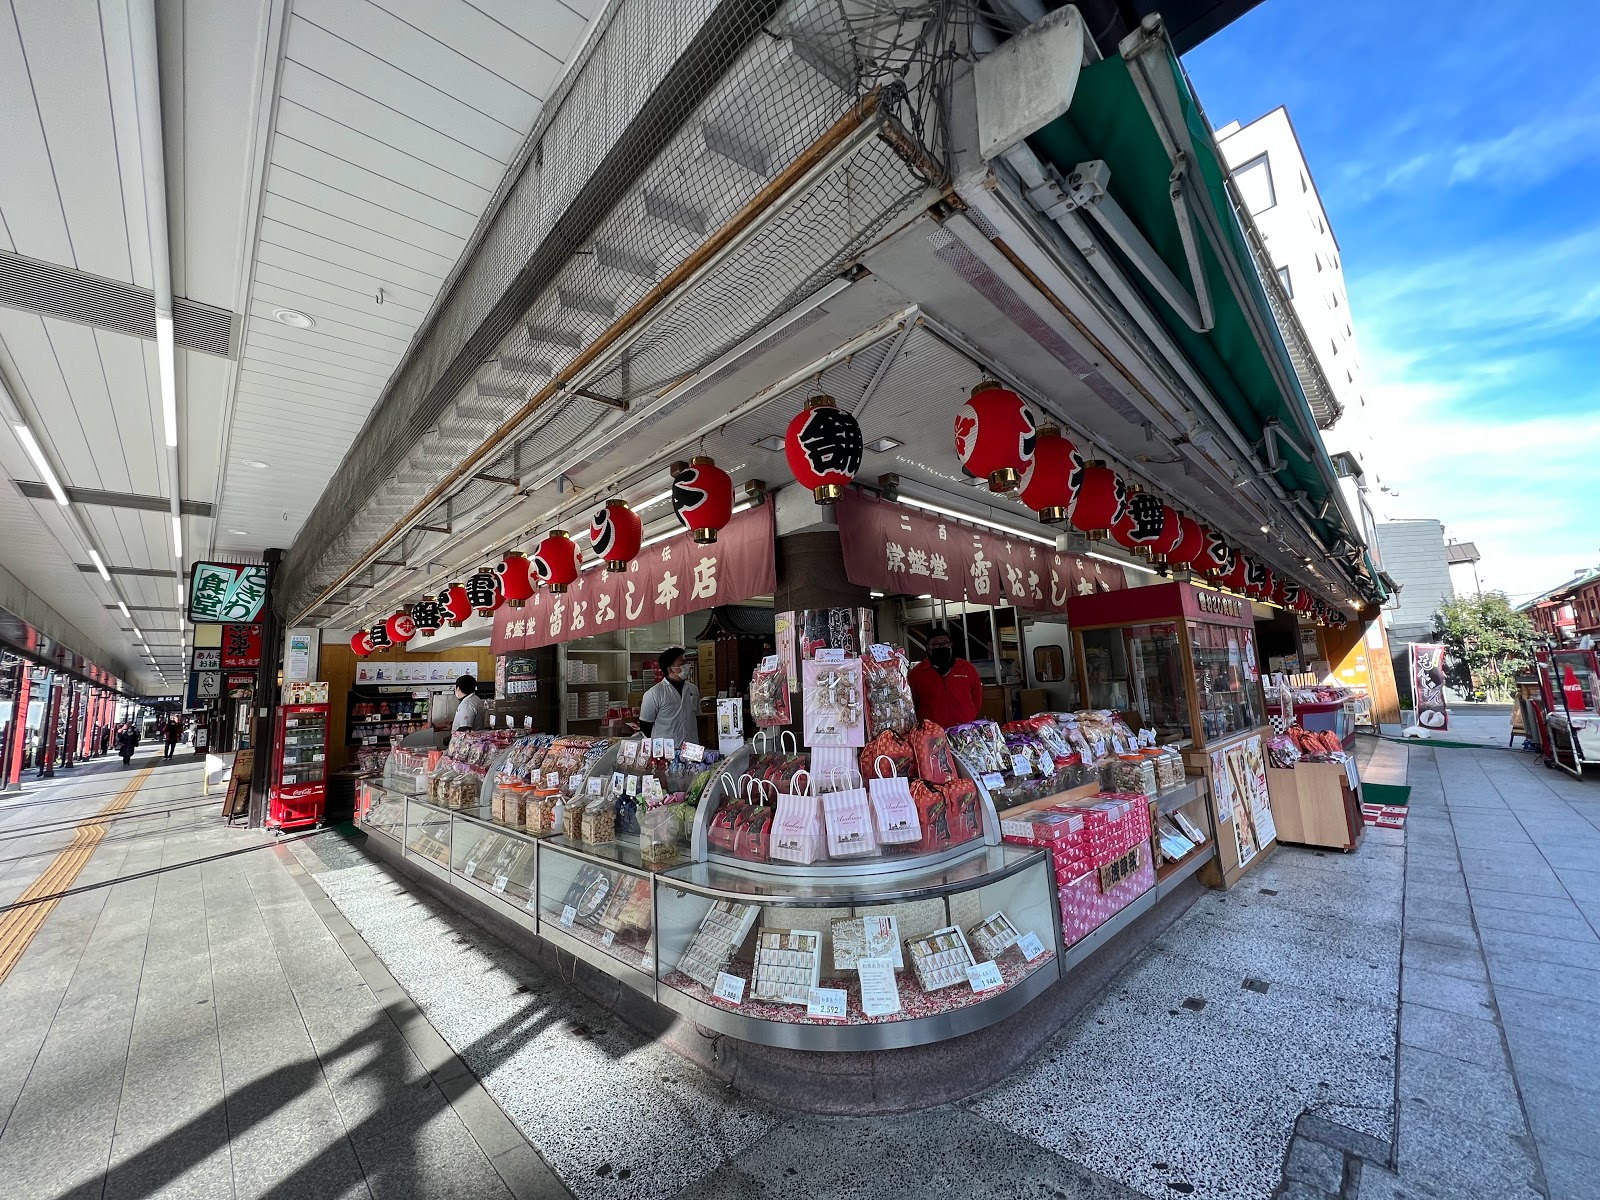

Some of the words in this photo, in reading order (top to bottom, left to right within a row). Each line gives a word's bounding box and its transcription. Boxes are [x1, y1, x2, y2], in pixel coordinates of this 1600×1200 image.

[886, 541, 949, 581] 常盤堂
[189, 572, 229, 617] 食堂
[292, 788, 312, 797] Coca-Cola
